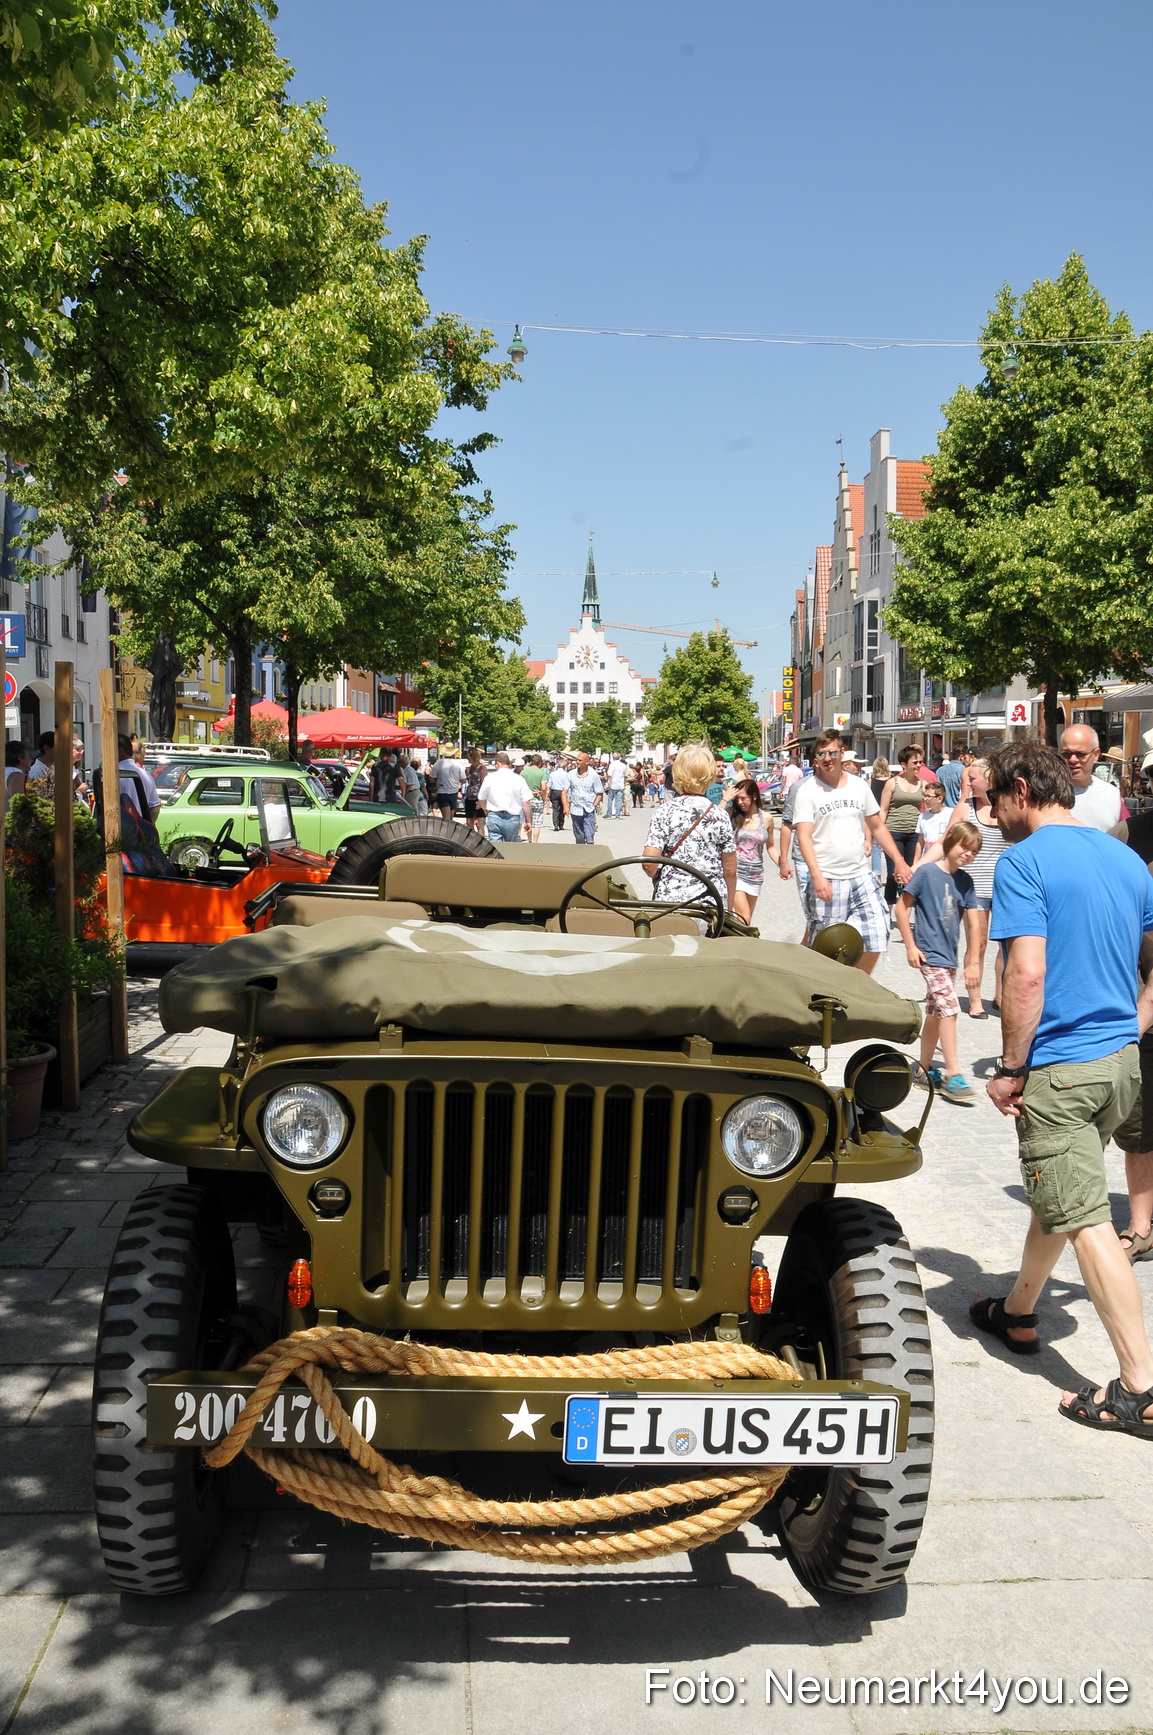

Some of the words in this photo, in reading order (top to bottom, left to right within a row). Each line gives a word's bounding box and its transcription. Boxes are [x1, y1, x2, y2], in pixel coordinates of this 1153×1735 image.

[783, 666, 794, 722] HOTEL
[576, 1437, 588, 1450] D
[603, 1406, 665, 1455] EI
[703, 1407, 771, 1455] US
